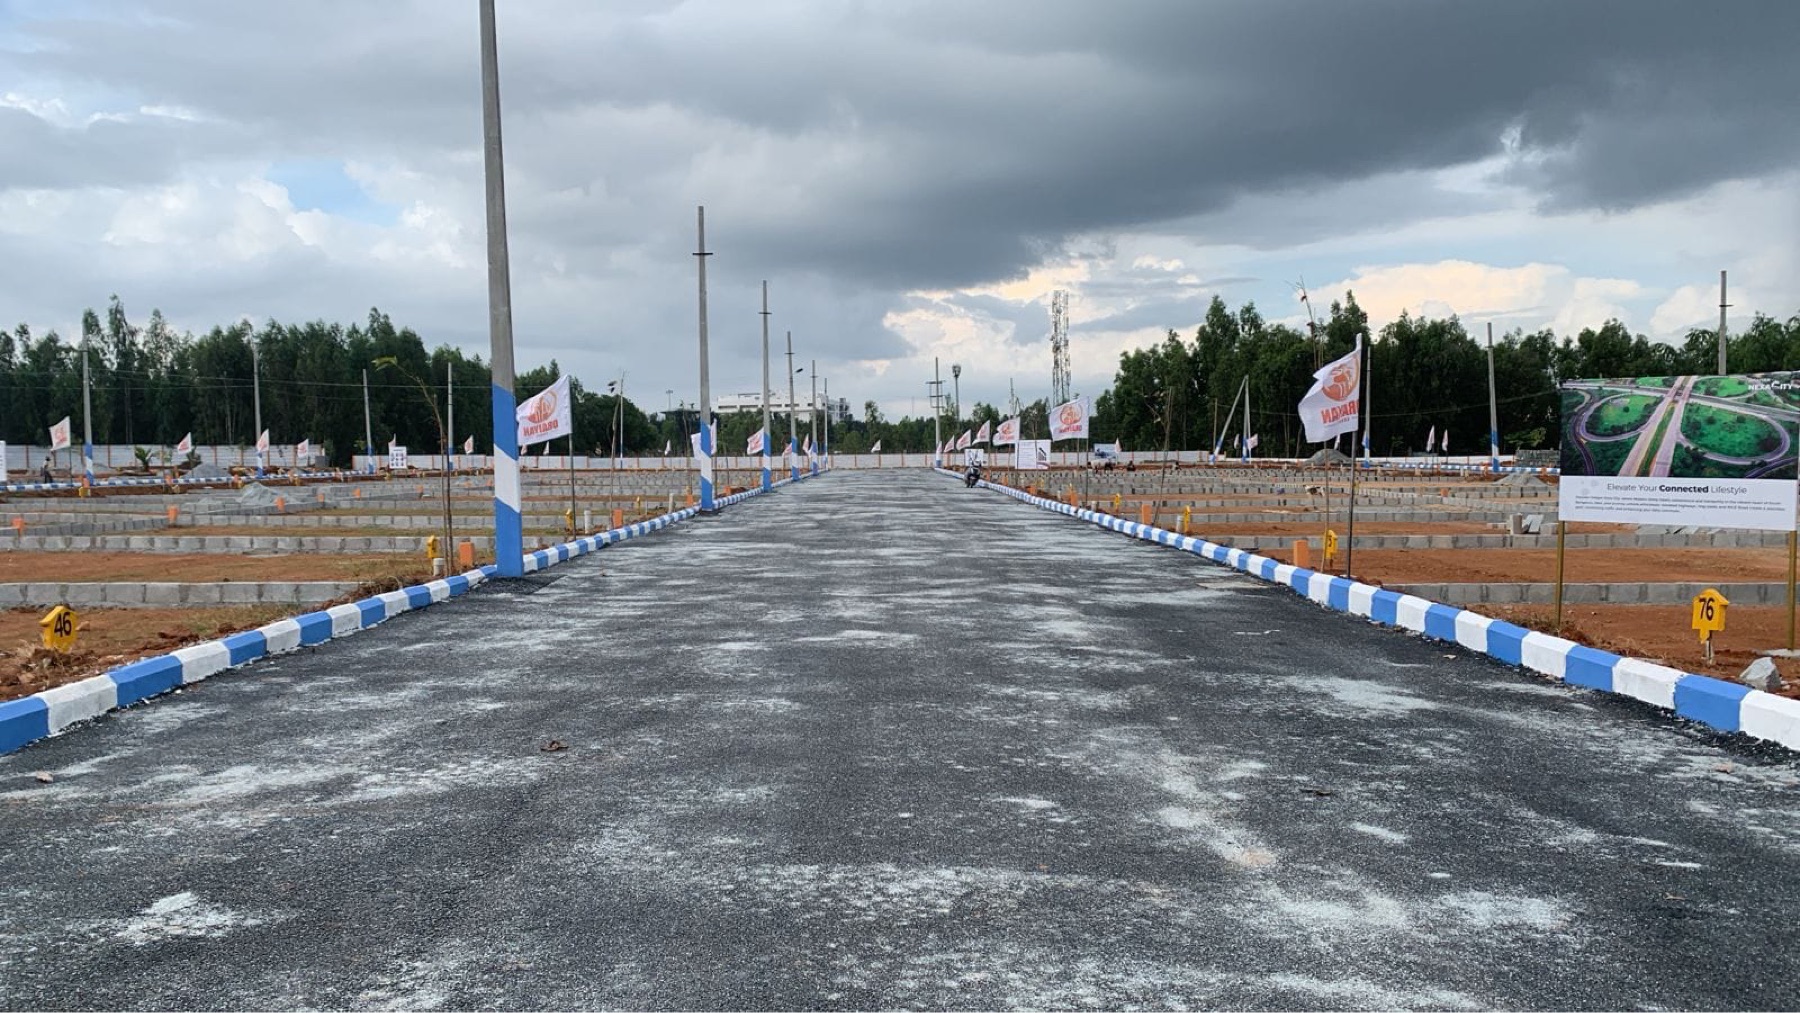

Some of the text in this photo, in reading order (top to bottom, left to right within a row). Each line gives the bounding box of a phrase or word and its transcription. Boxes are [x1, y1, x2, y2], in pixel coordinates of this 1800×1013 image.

[1607, 483, 1748, 495] Elevate Your Connected Lifestyle
[1699, 597, 1715, 621] 76
[54, 611, 72, 637] 46
